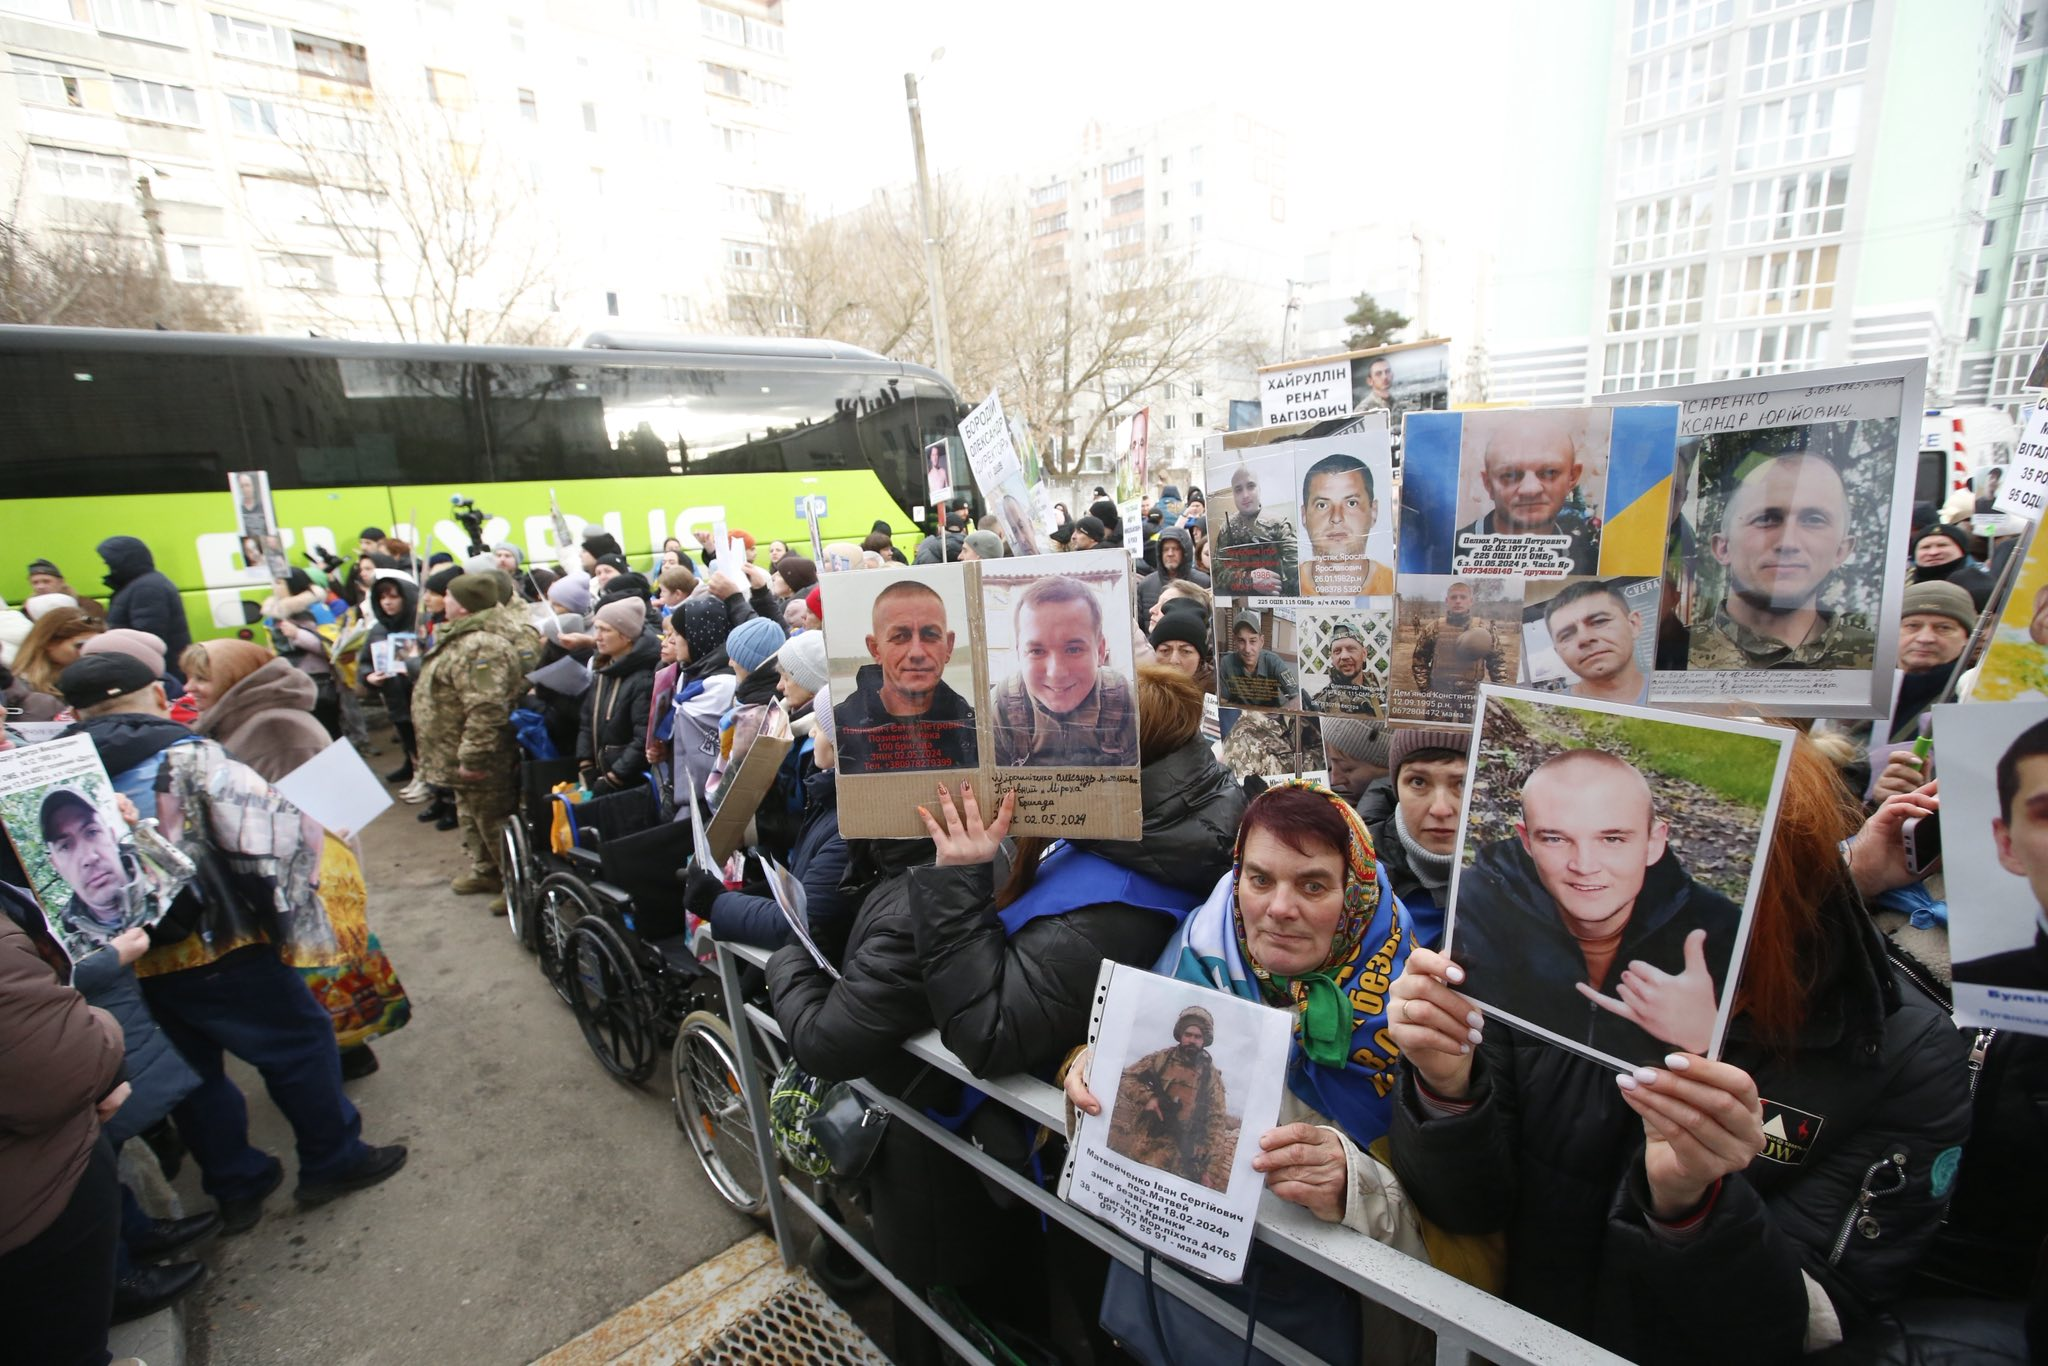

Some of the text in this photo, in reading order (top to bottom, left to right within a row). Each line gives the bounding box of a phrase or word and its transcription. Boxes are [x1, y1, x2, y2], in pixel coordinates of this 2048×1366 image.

[1268, 368, 1346, 390] ХАЙРУЛЛІН
[1286, 389, 1329, 405] РЕНАТ
[1270, 404, 1347, 424] ВАГІЗОВИЧ
[1681, 412, 1749, 434] КСАНДР
[2021, 467, 2034, 481] 35
[2008, 488, 2020, 502] 95
[1493, 537, 1522, 546] Руслан
[1525, 538, 1567, 546] Петрович
[1557, 561, 1569, 569] Яр
[1393, 699, 1435, 708] 12.09.1995
[878, 742, 893, 751] 100
[895, 750, 941, 760] 02.05.2024
[1025, 814, 1086, 827] 02.05.2024
[1086, 1147, 1244, 1224] Матвейченко Іван Сергійович
[1091, 1170, 1231, 1239] зник безвісти 18.02.2024р
[1127, 1180, 1190, 1213] поз.Матвей
[1079, 1180, 1091, 1192] 38
[1097, 1191, 1138, 1219] бригада
[1139, 1215, 1199, 1247] Мор.піхота
[1201, 1241, 1238, 1262] А4765
[1124, 1199, 1186, 1232] н.п. Кринки
[1099, 1202, 1118, 1215] 097
[1119, 1212, 1138, 1227] 717
[1139, 1224, 1153, 1236] 55
[1154, 1231, 1168, 1243] 91
[1176, 1242, 1208, 1260] мама
